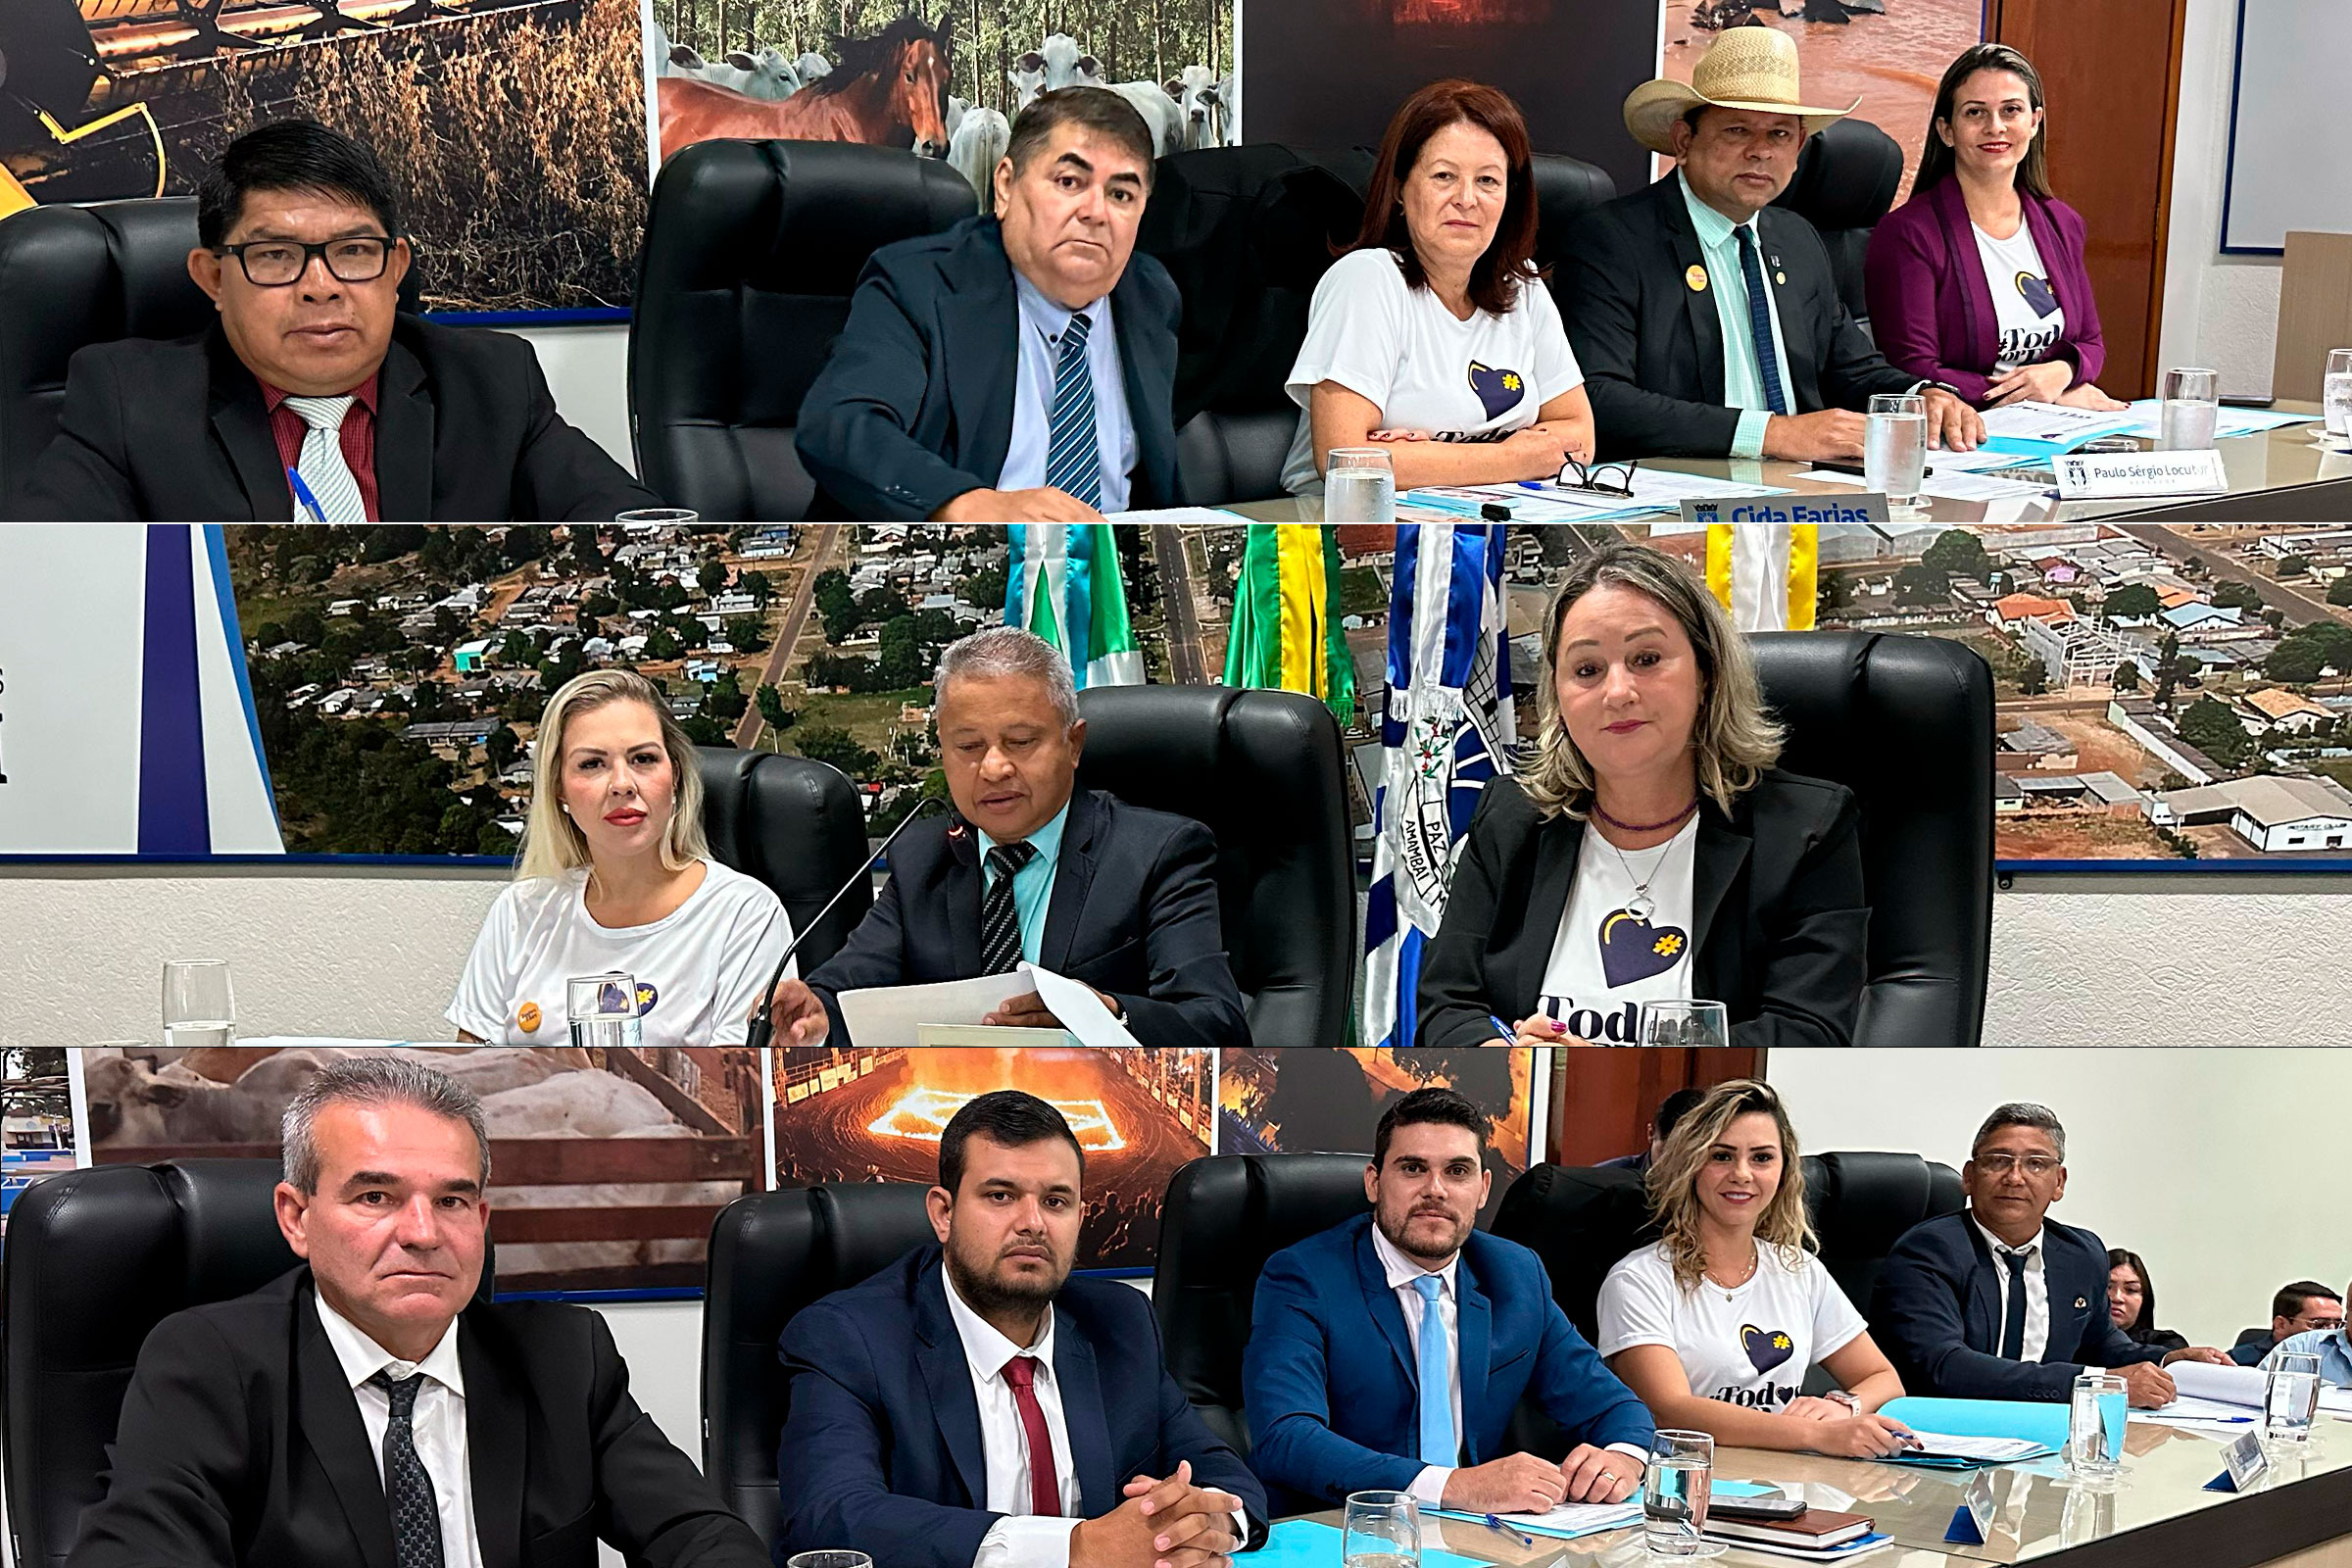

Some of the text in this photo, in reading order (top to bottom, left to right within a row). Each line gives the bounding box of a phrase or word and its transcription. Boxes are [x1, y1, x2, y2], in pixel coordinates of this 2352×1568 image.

[2094, 466, 2127, 478] Paulo
[2128, 465, 2164, 479] Sérgio
[1732, 503, 1870, 522] Cida Farias
[1405, 819, 1430, 882] AMAMBAI
[1426, 821, 1446, 854] PAZ
